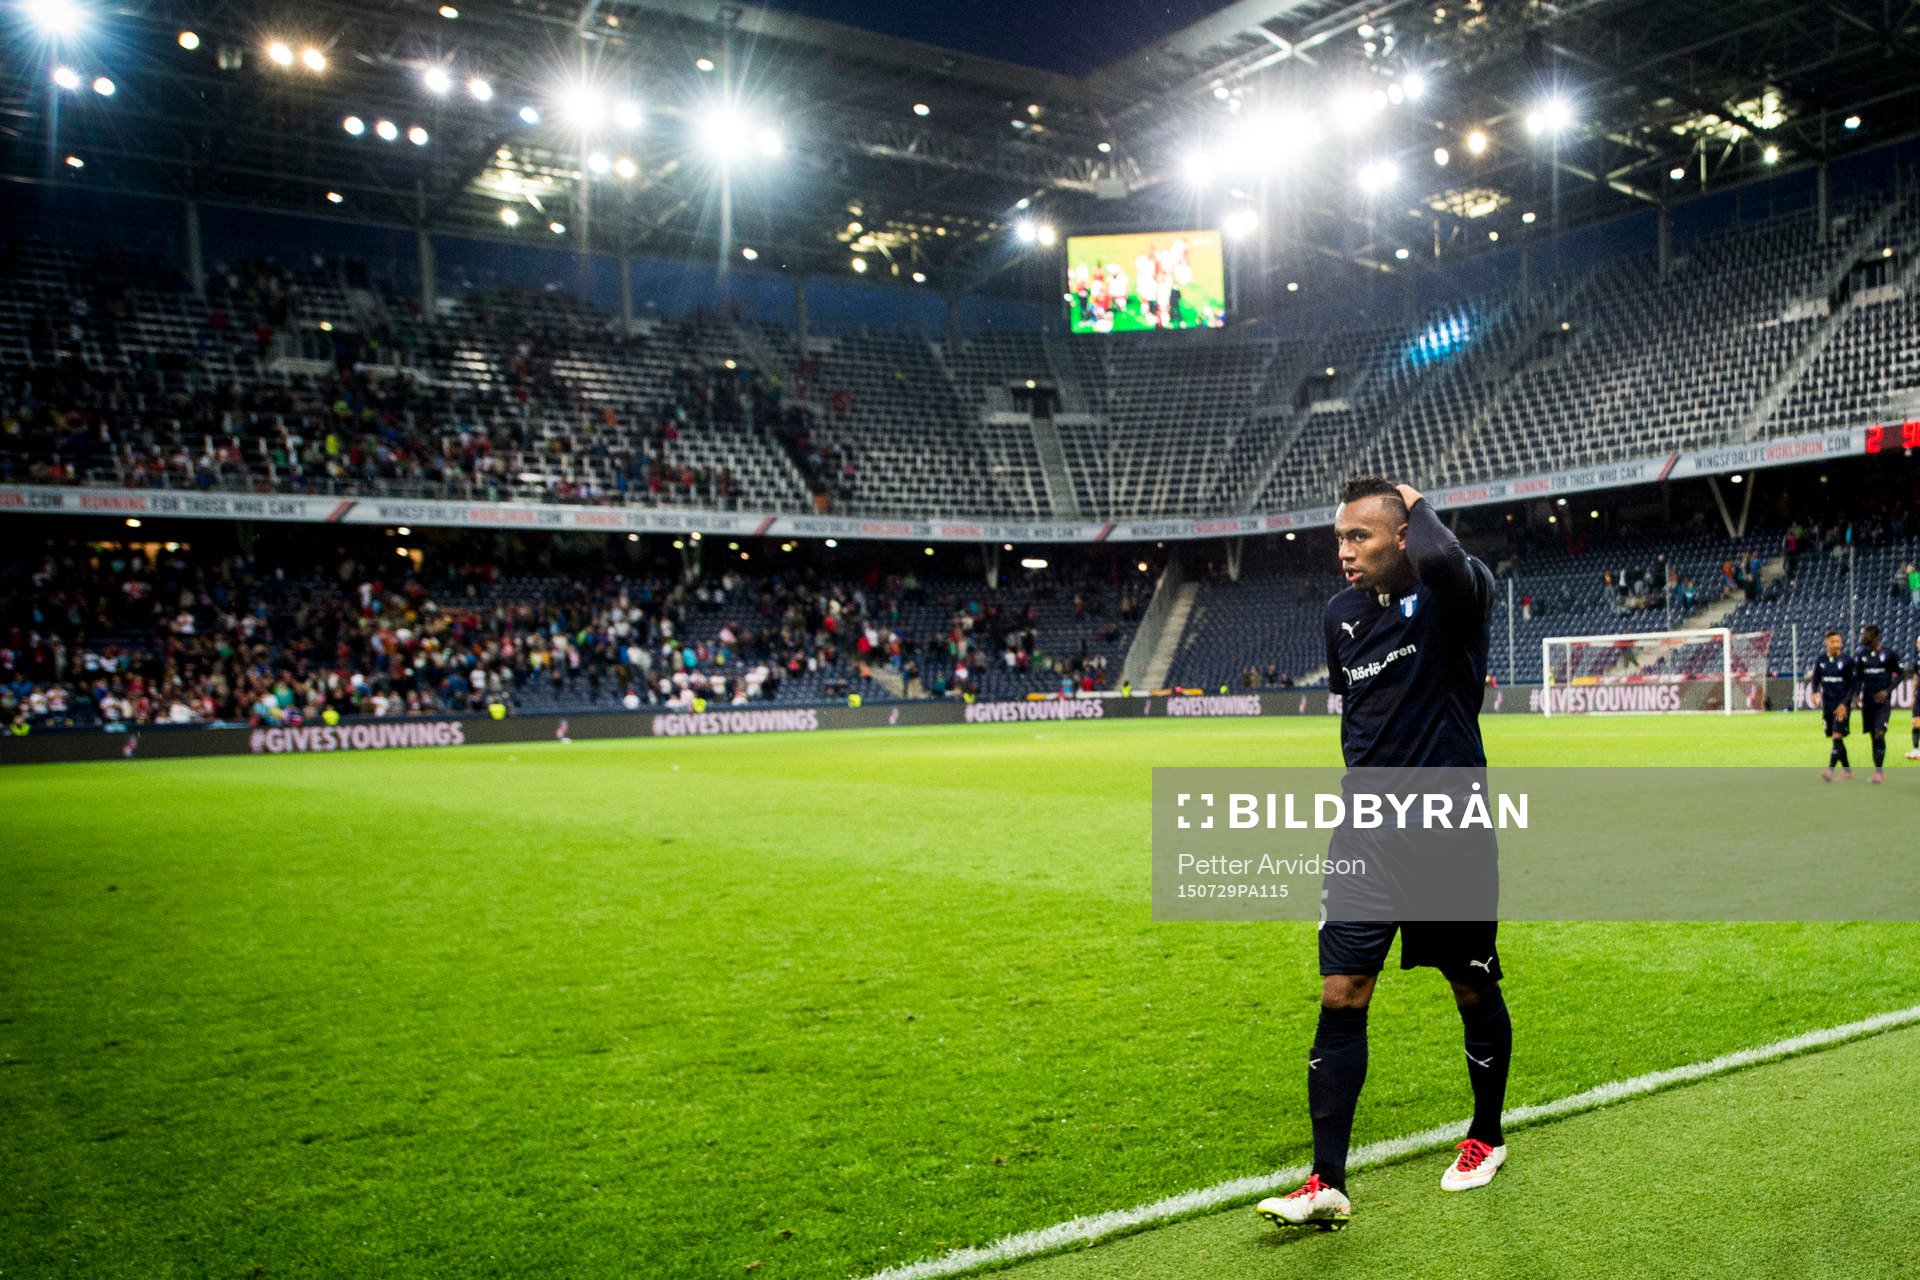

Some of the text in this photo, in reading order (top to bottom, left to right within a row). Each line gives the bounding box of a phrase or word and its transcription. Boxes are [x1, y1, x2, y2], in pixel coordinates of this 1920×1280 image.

[1695, 435, 1851, 469] WINGSFORLIFEWORLDRUN.COM
[1866, 424, 1884, 454] 2
[1552, 476, 1567, 490] FOR
[1570, 471, 1595, 487] THOSE
[1599, 469, 1617, 484] WHO
[1620, 464, 1644, 480] CAN'T
[965, 699, 1104, 723] #GIVESYOUWINGS
[1167, 694, 1261, 716] #GIVESYOUWINGS
[1530, 685, 1681, 712] #GIVESYOUWINGS
[652, 709, 818, 736] #GIVESYOUWINGS
[249, 721, 465, 753] #GIVESYOUWINGS
